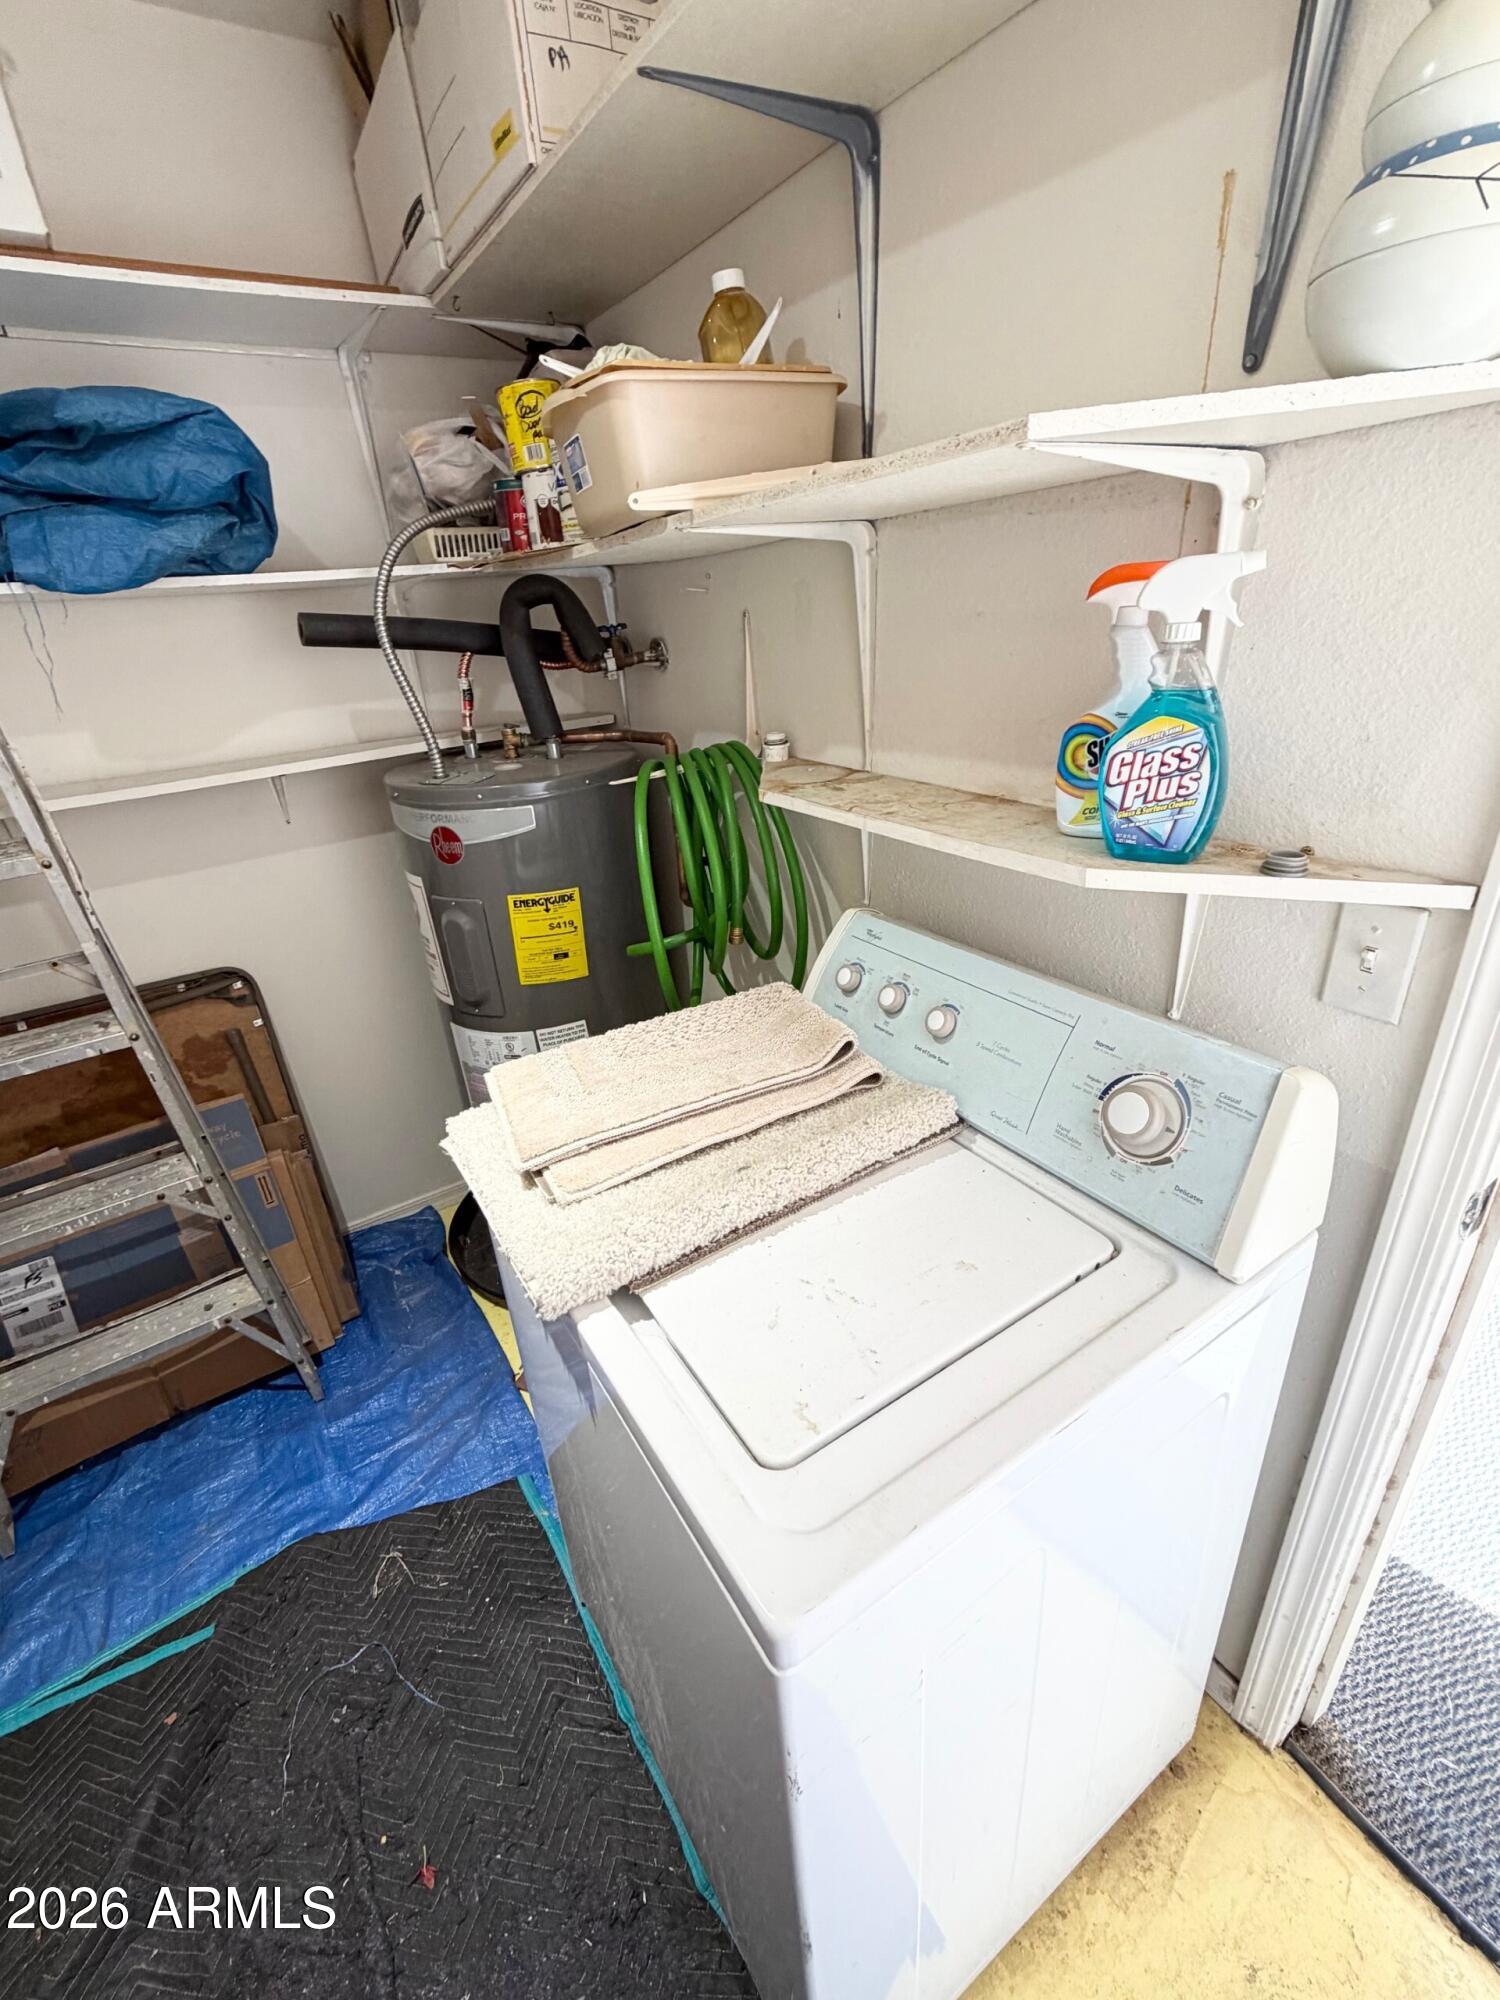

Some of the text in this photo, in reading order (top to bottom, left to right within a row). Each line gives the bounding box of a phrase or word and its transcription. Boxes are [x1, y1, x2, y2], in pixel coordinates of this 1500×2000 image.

[1106, 742, 1202, 787] Glass
[1119, 771, 1201, 811] Plus
[432, 827, 462, 859] Rheem
[513, 892, 576, 912] ENERGYGUIDE
[548, 919, 575, 931] $419
[1095, 1040, 1116, 1053] Normal
[1218, 1091, 1242, 1105] Casual
[1174, 1184, 1204, 1205] Delicates
